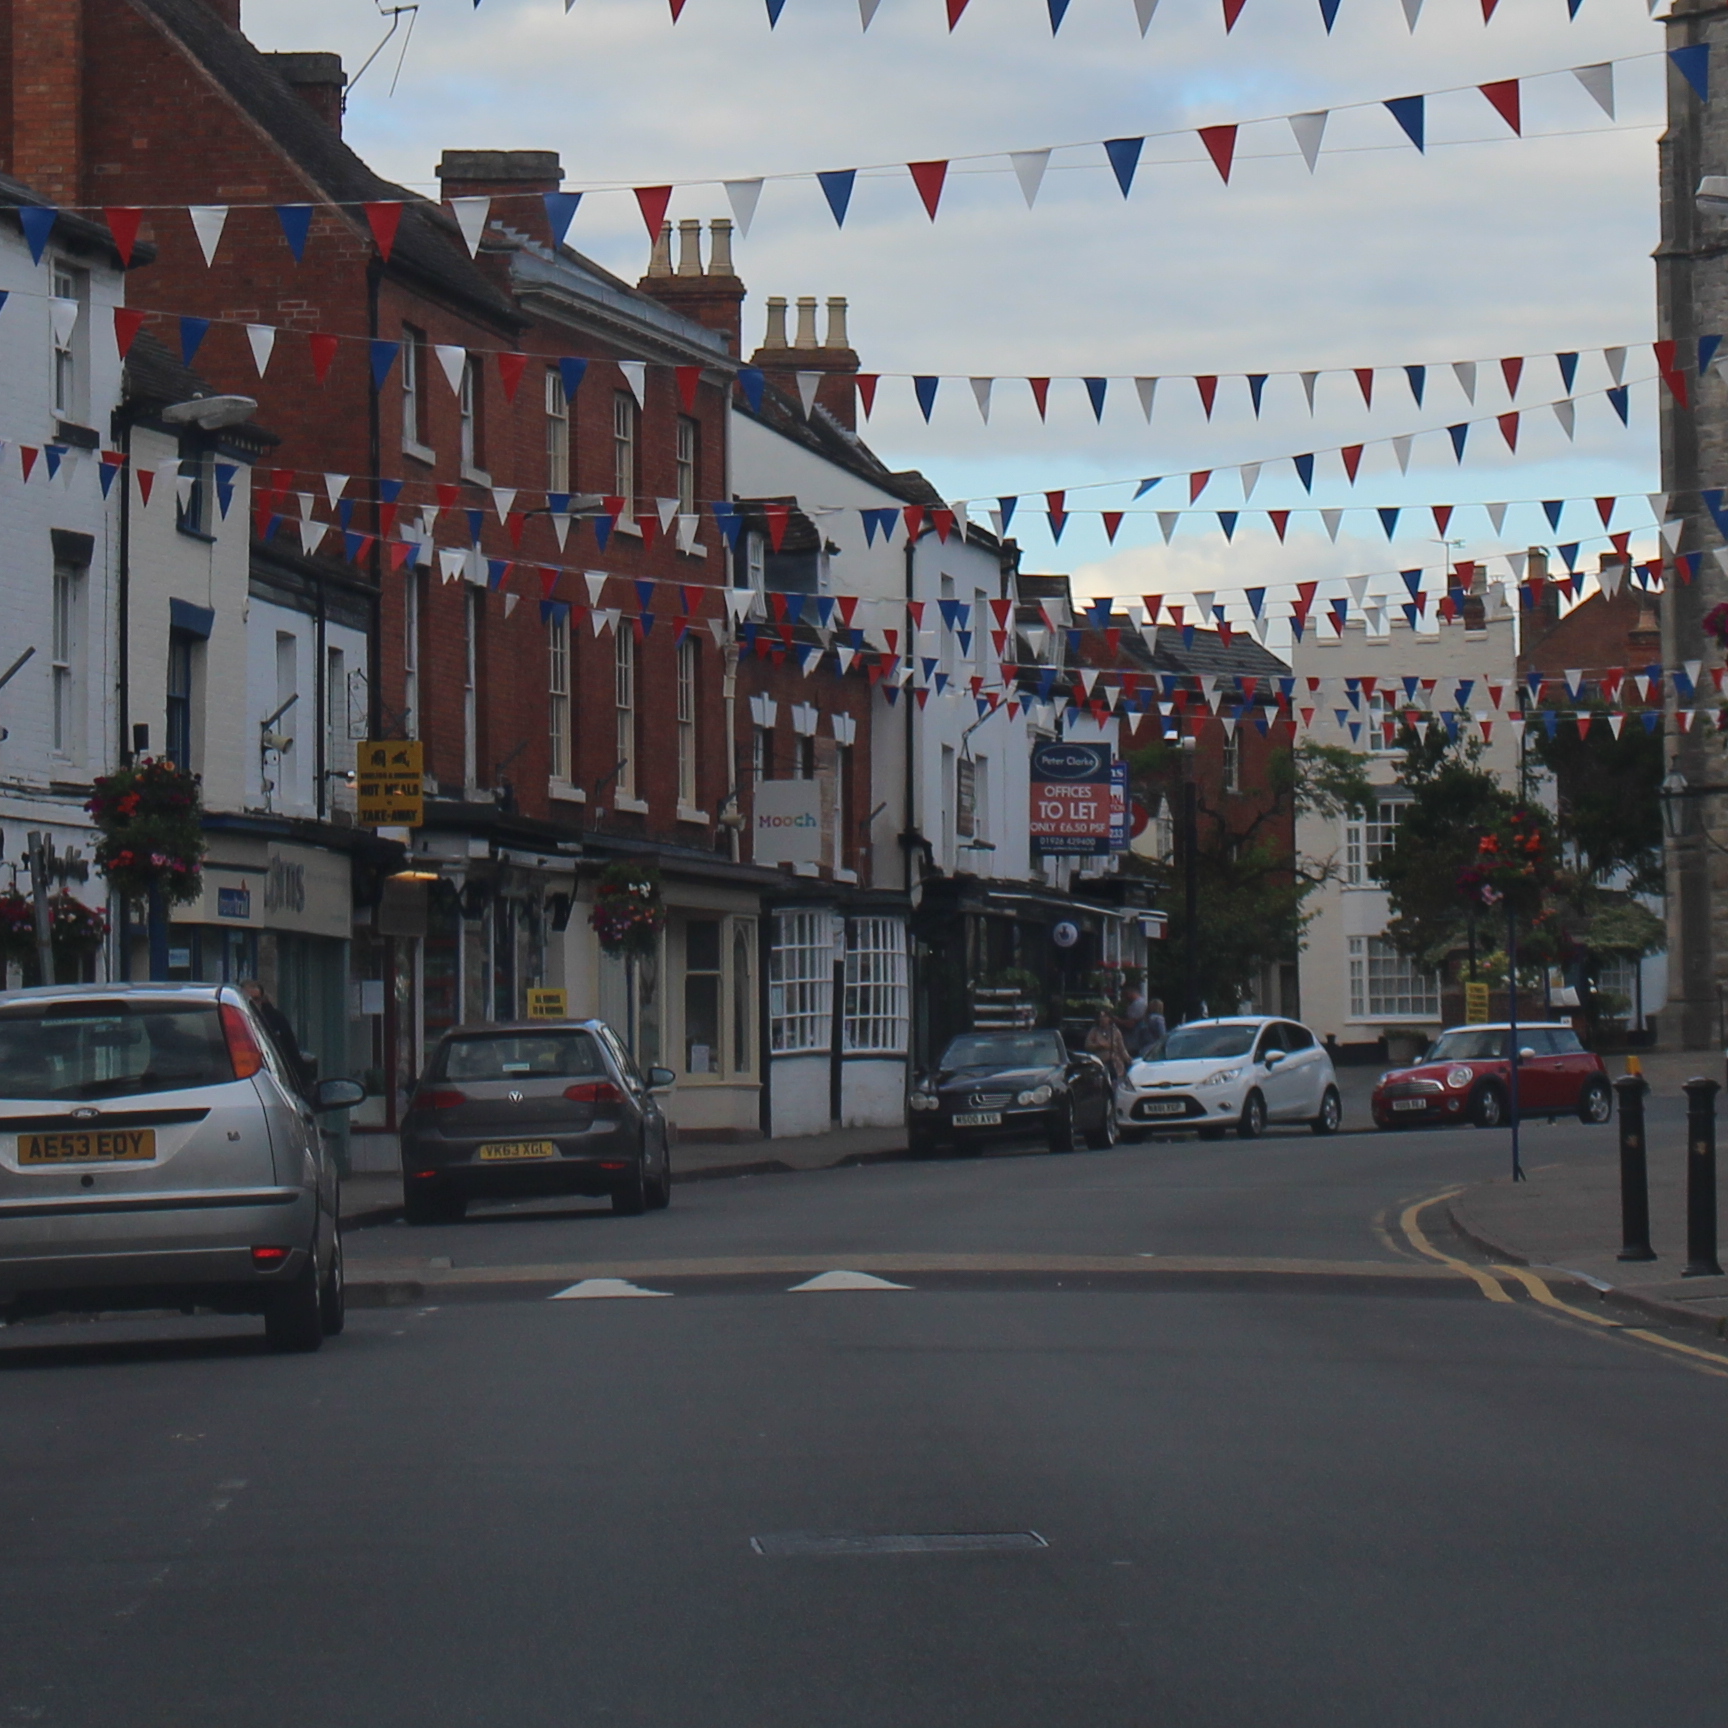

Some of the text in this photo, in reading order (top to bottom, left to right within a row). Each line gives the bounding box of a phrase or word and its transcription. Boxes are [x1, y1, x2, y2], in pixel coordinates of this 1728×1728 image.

[1042, 756, 1094, 765] Peter Clarke
[360, 784, 379, 796] HOT
[1044, 785, 1092, 798] OFFICES
[362, 809, 418, 821] TAKE-AWAY
[1038, 801, 1098, 819] TO LET
[759, 813, 816, 828] Mooch
[1030, 822, 1105, 832] ONLY £6.50 PSF
[29, 1136, 90, 1159] AE53
[485, 1144, 519, 1157] VK63
